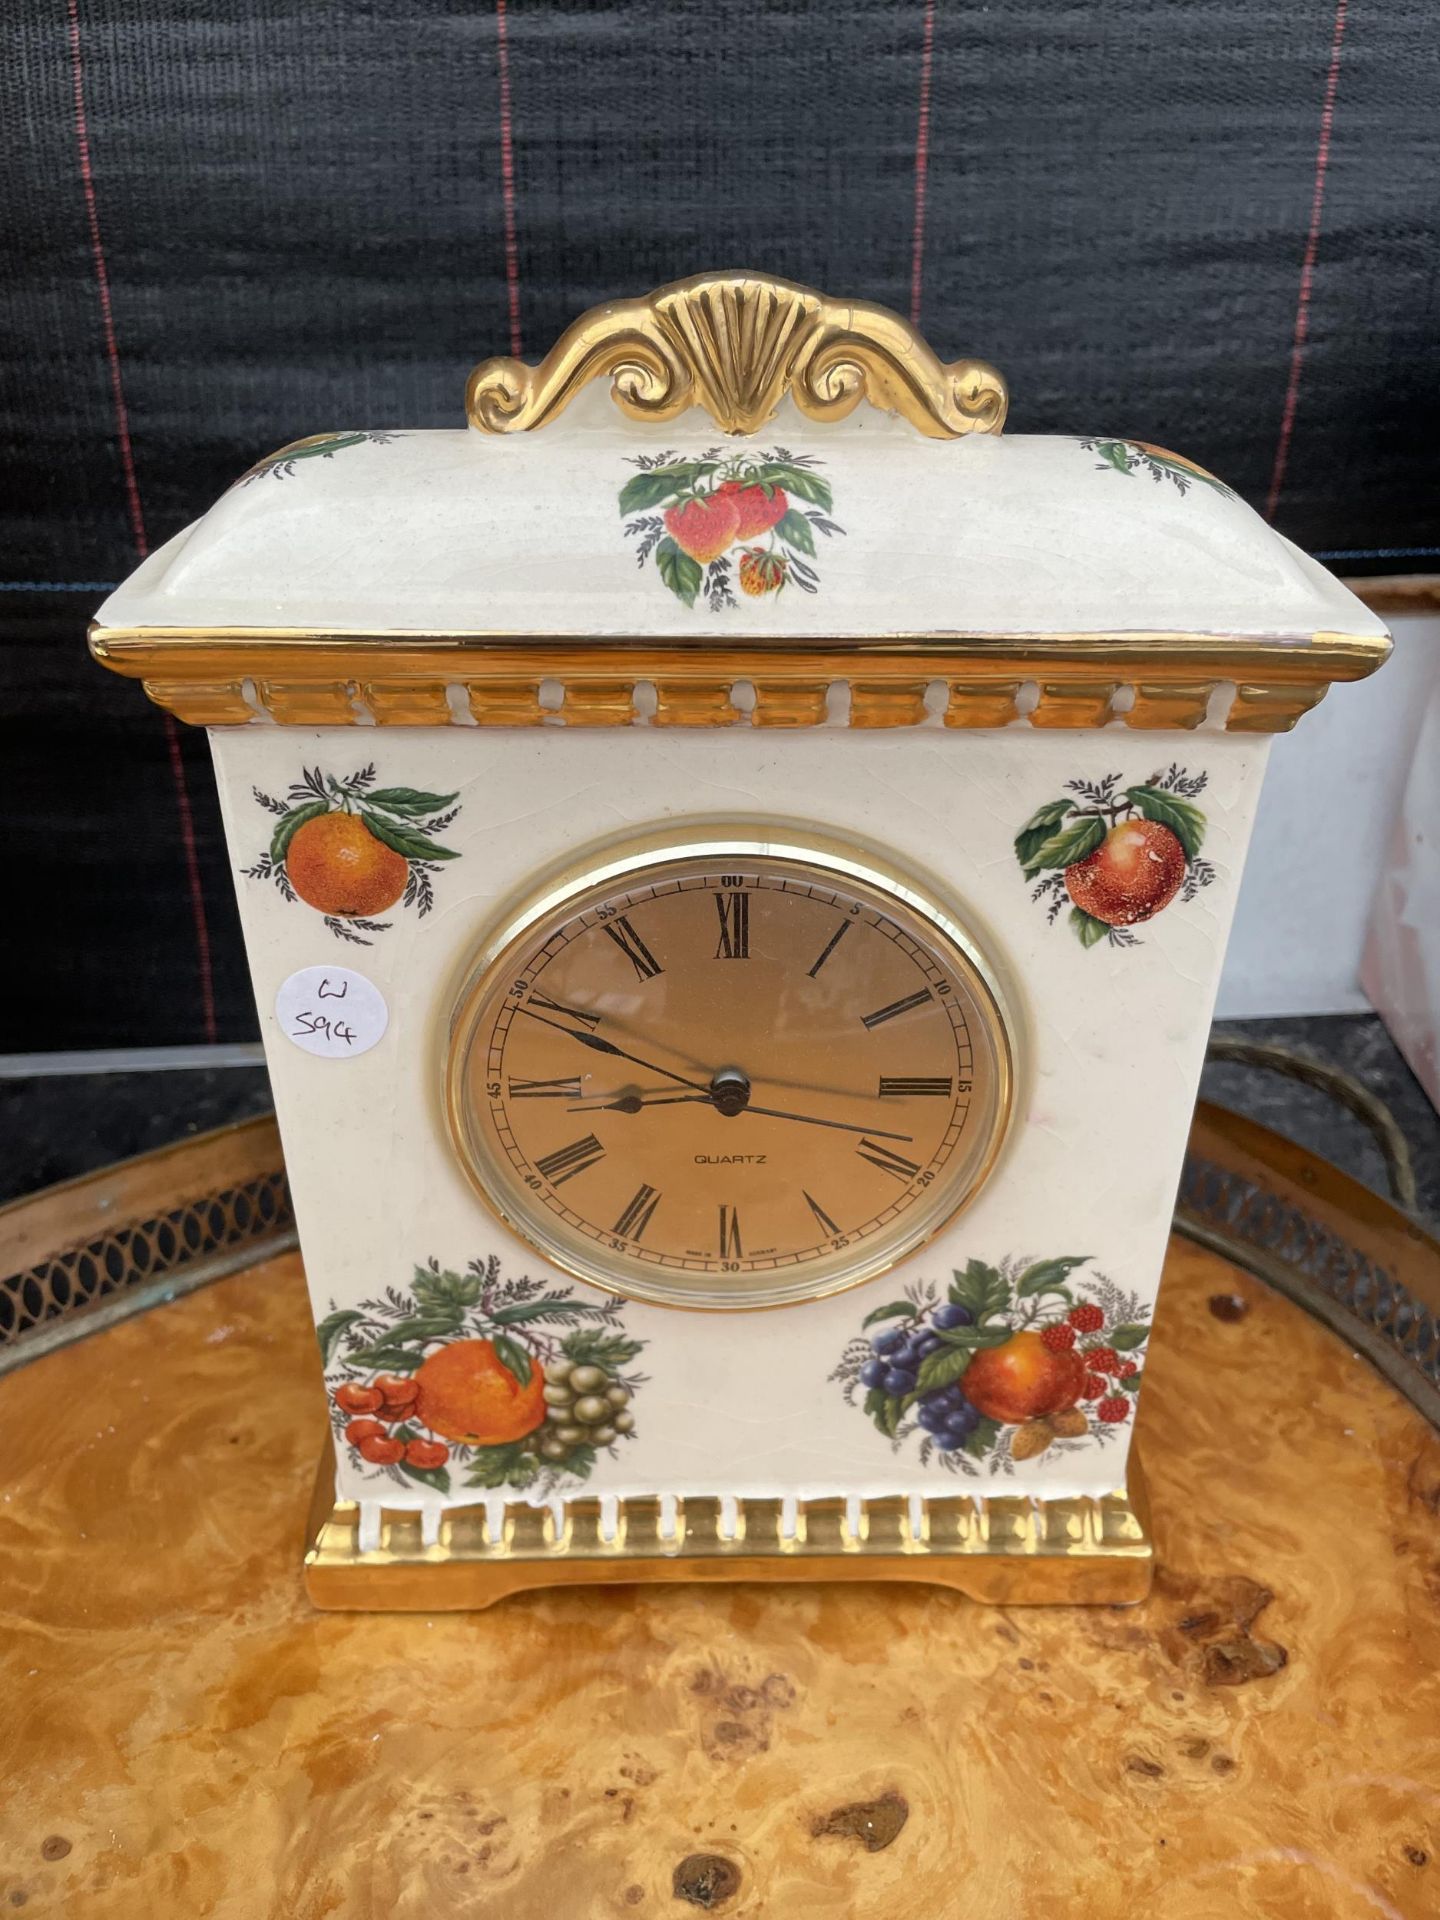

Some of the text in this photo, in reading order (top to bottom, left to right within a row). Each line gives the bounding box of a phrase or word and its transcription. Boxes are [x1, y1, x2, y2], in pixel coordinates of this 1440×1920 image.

[595, 901, 617, 920] 55
[849, 902, 863, 915] 5
[713, 892, 752, 959] XII
[600, 914, 666, 984] XI
[805, 918, 855, 979] I
[509, 979, 529, 999] 50
[933, 979, 951, 995] 10
[527, 989, 600, 1032] X
[860, 986, 934, 1031] II
[487, 1082, 501, 1099] 45
[508, 1075, 581, 1100] IX
[879, 1075, 952, 1099] III
[958, 1080, 972, 1093] 15
[534, 1132, 607, 1190] VIII
[694, 1155, 767, 1164] QUARTZ
[855, 1137, 922, 1185] IV
[524, 1173, 542, 1190] 40
[916, 1170, 935, 1187] 20
[610, 1183, 662, 1243] VII
[802, 1189, 842, 1239] V
[718, 1204, 743, 1259] VI
[608, 1240, 628, 1252] 35
[831, 1237, 850, 1250] 25
[721, 1262, 740, 1272] 30
